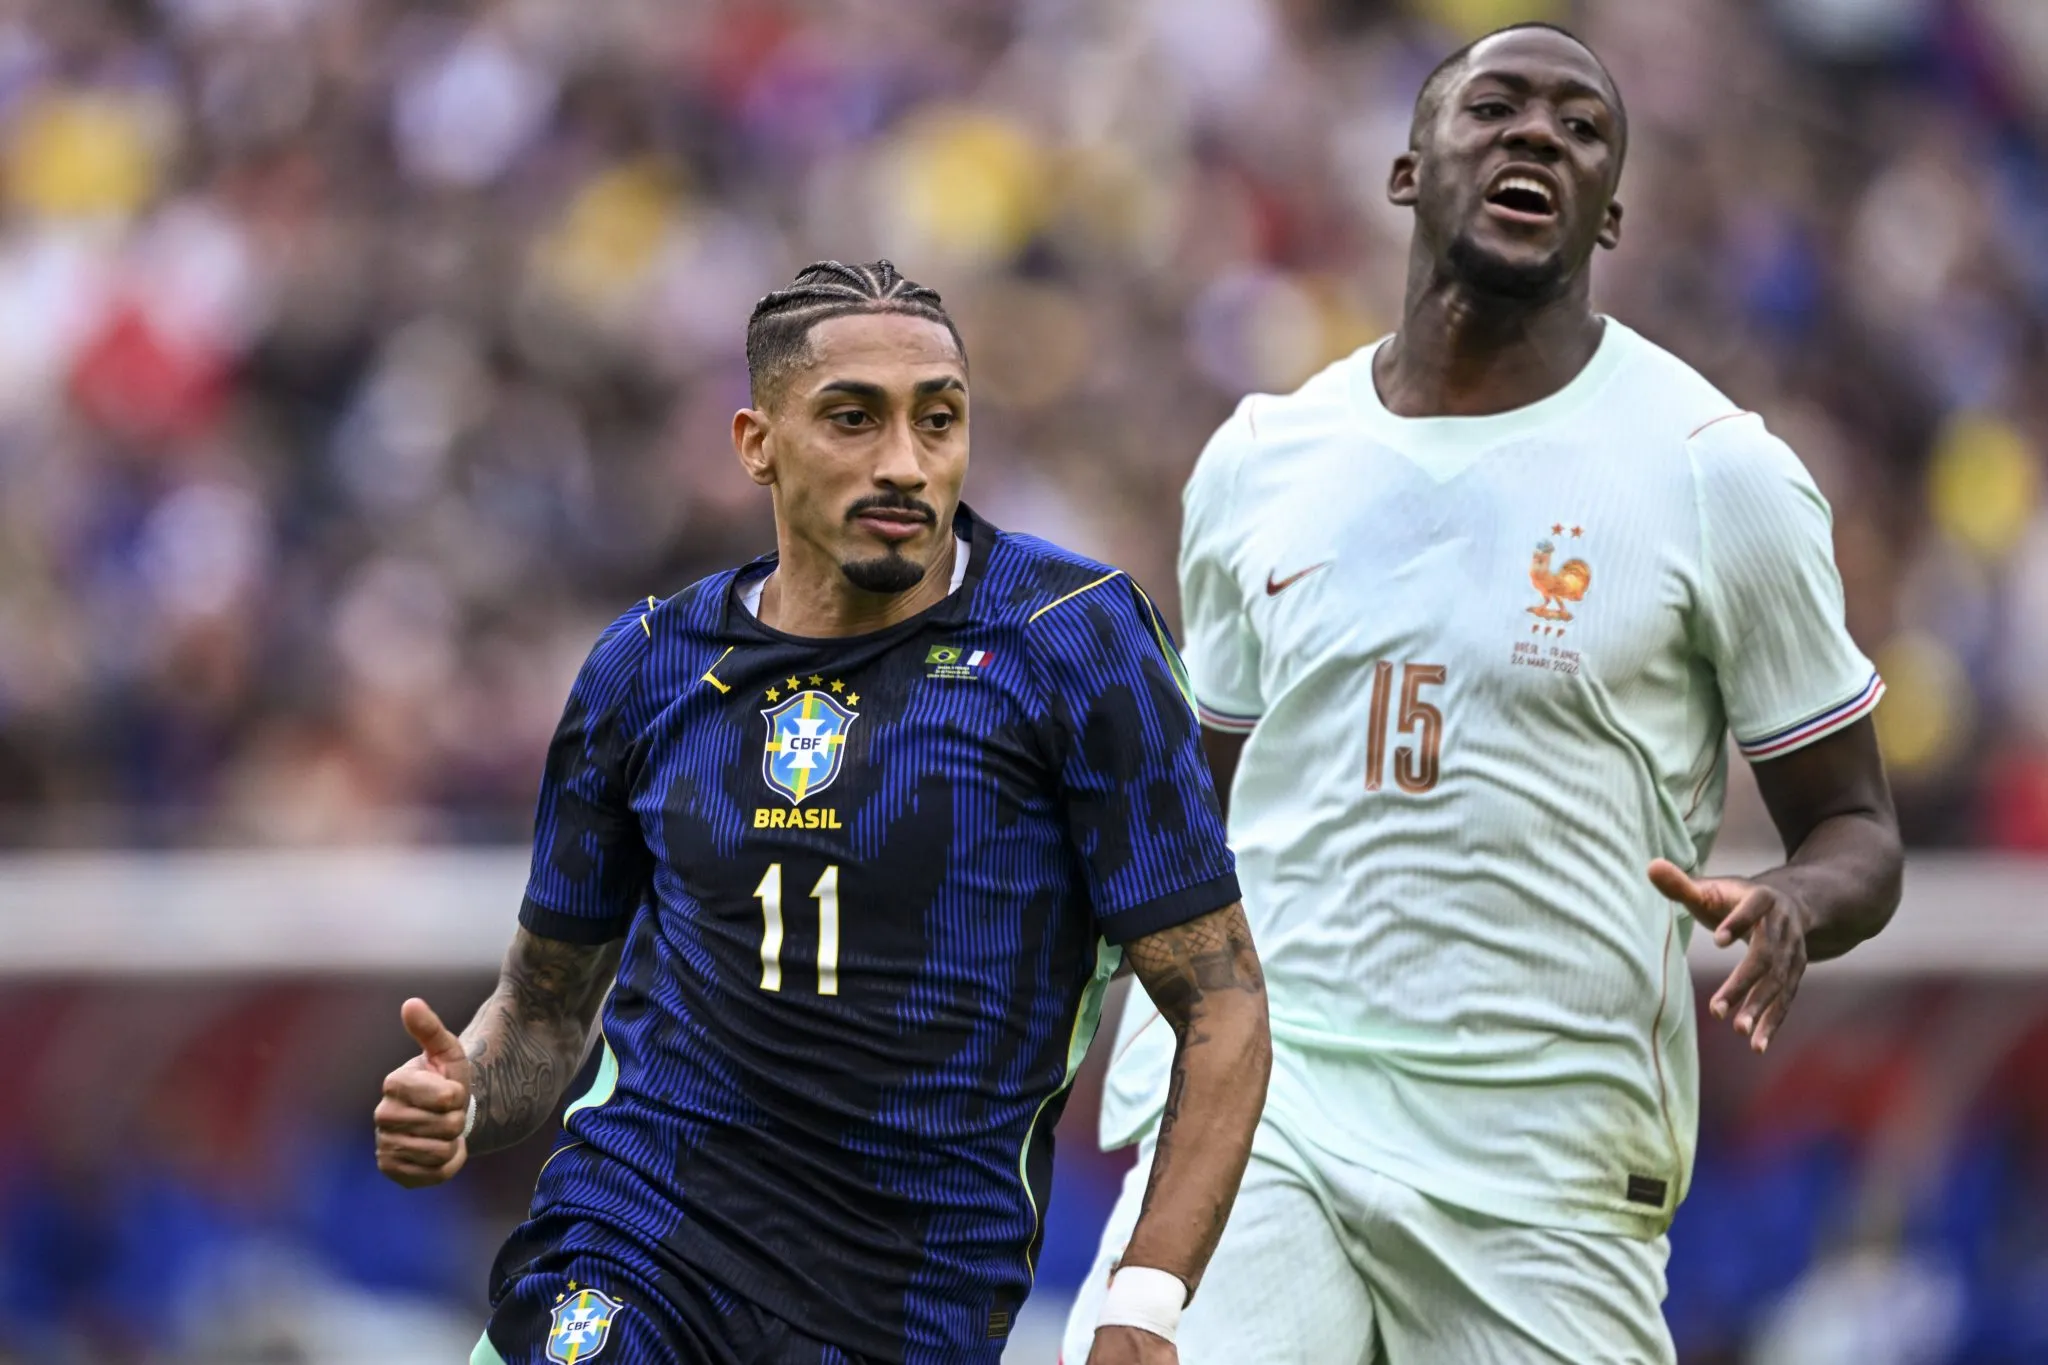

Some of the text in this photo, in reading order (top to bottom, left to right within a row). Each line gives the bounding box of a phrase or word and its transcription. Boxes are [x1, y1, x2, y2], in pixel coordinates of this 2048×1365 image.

[1365, 660, 1447, 794] 15
[790, 737, 822, 750] CBF
[753, 808, 842, 829] BRASIL
[752, 863, 839, 996] 11
[567, 1321, 591, 1331] CBF
